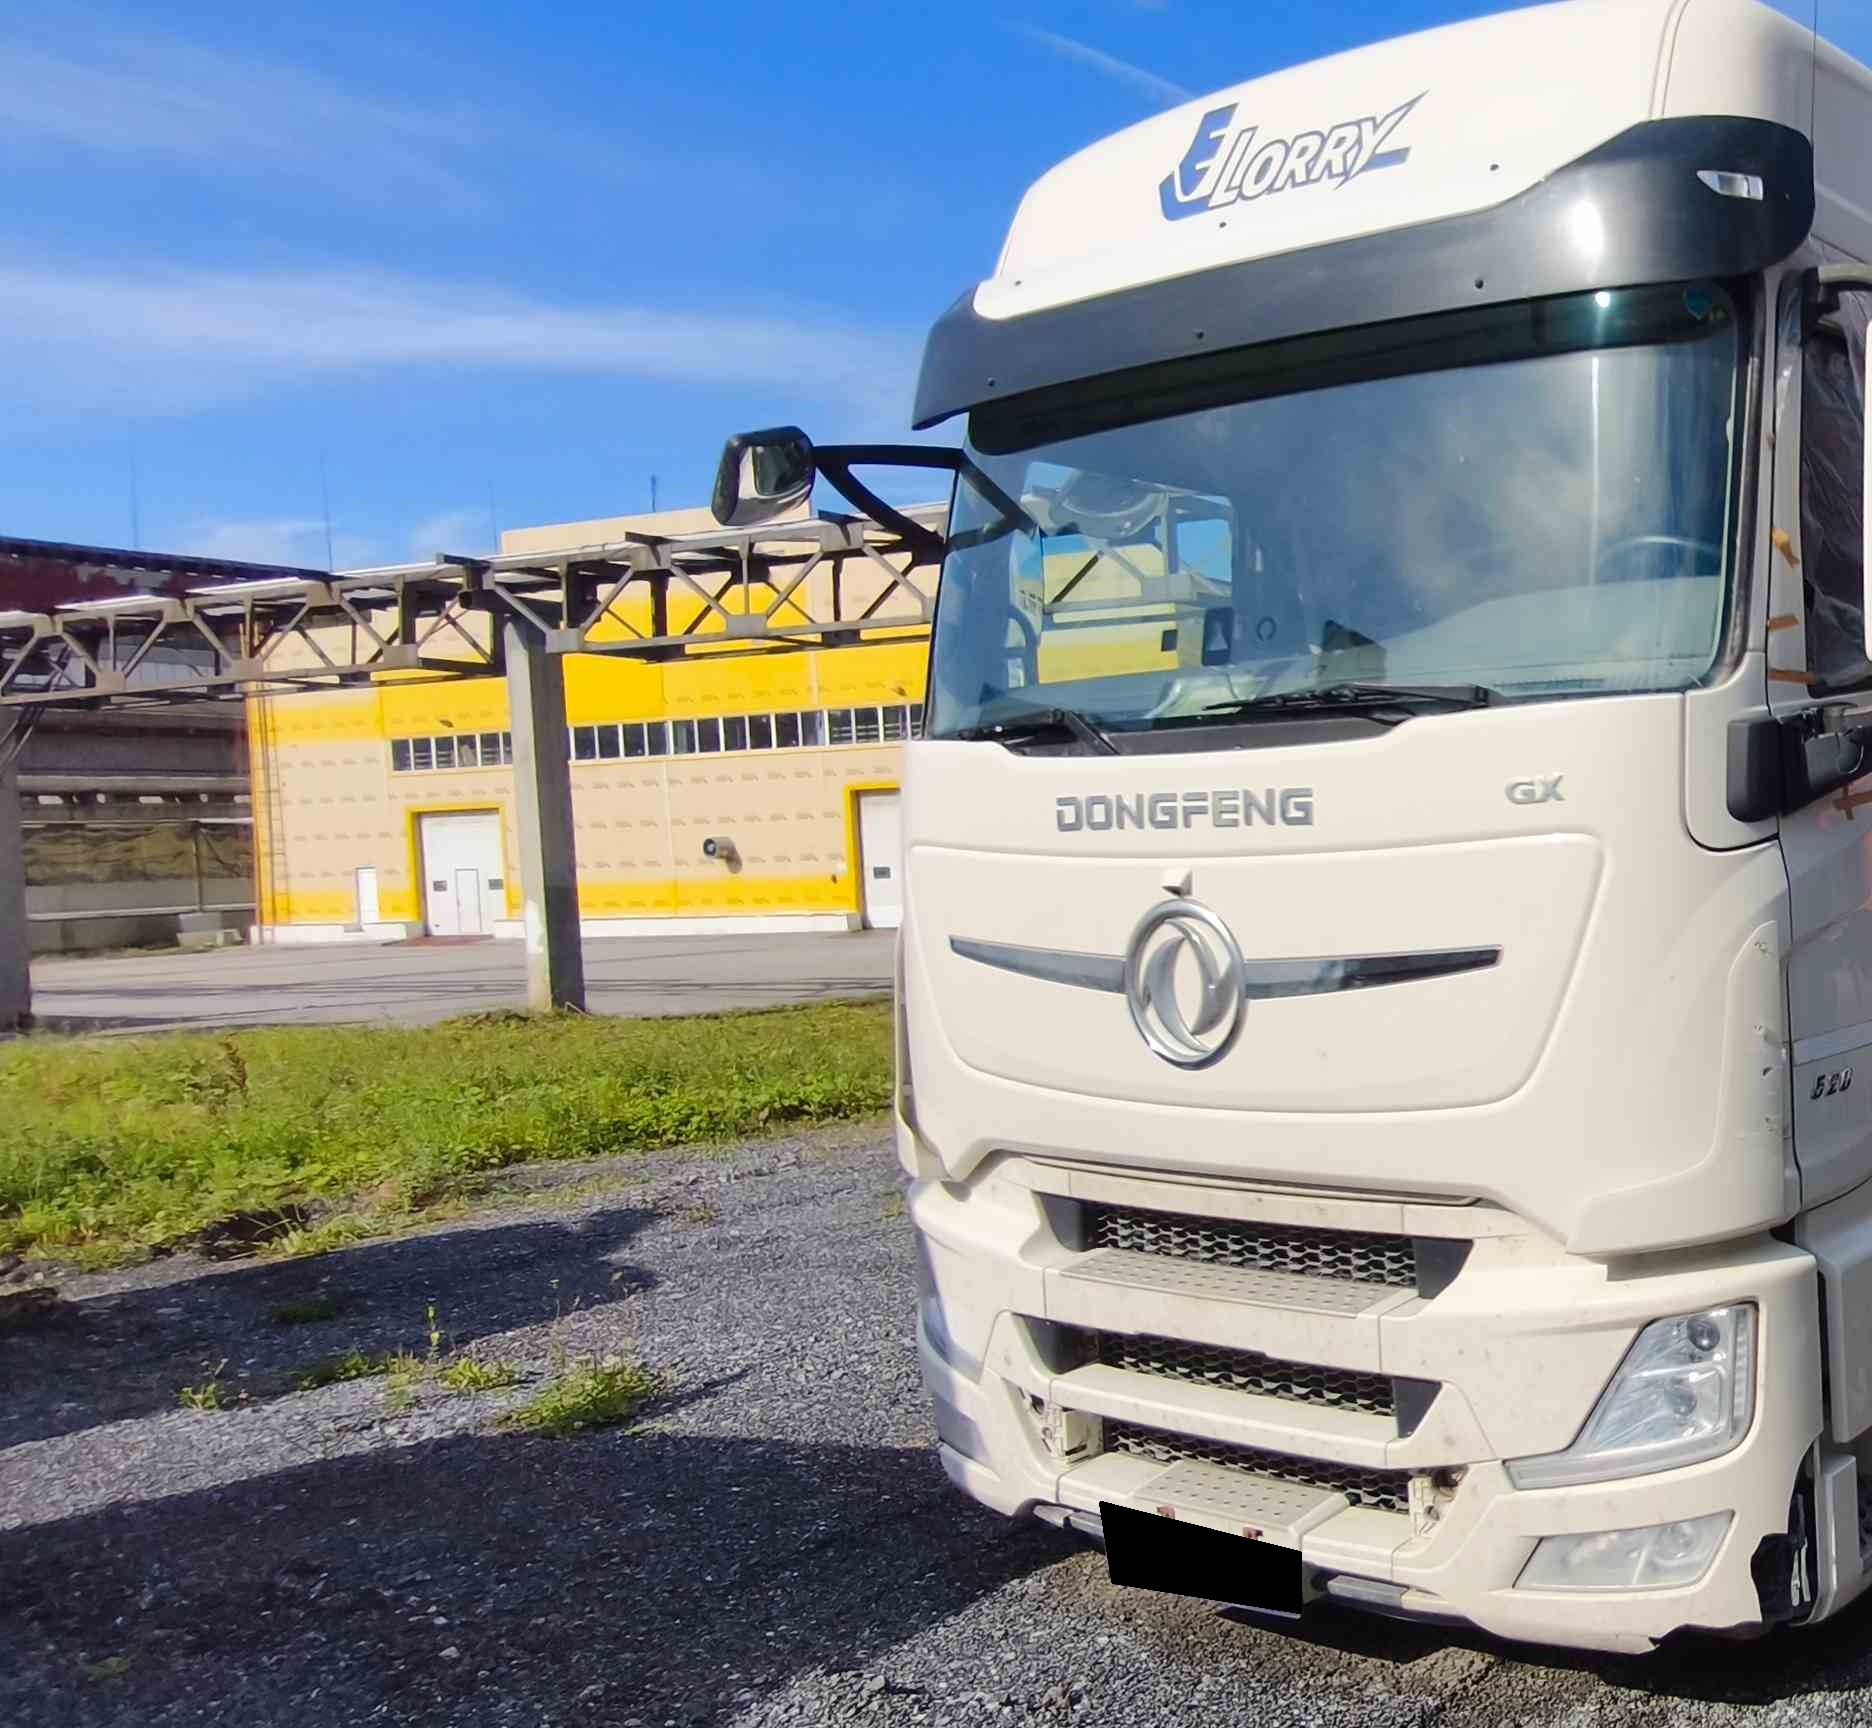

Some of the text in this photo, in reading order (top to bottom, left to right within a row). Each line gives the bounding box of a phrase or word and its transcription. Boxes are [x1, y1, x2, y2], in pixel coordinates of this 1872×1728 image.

[1504, 775, 1565, 805] GX
[1056, 787, 1314, 832] DONGFENG
[1810, 1066, 1854, 1100] 520
